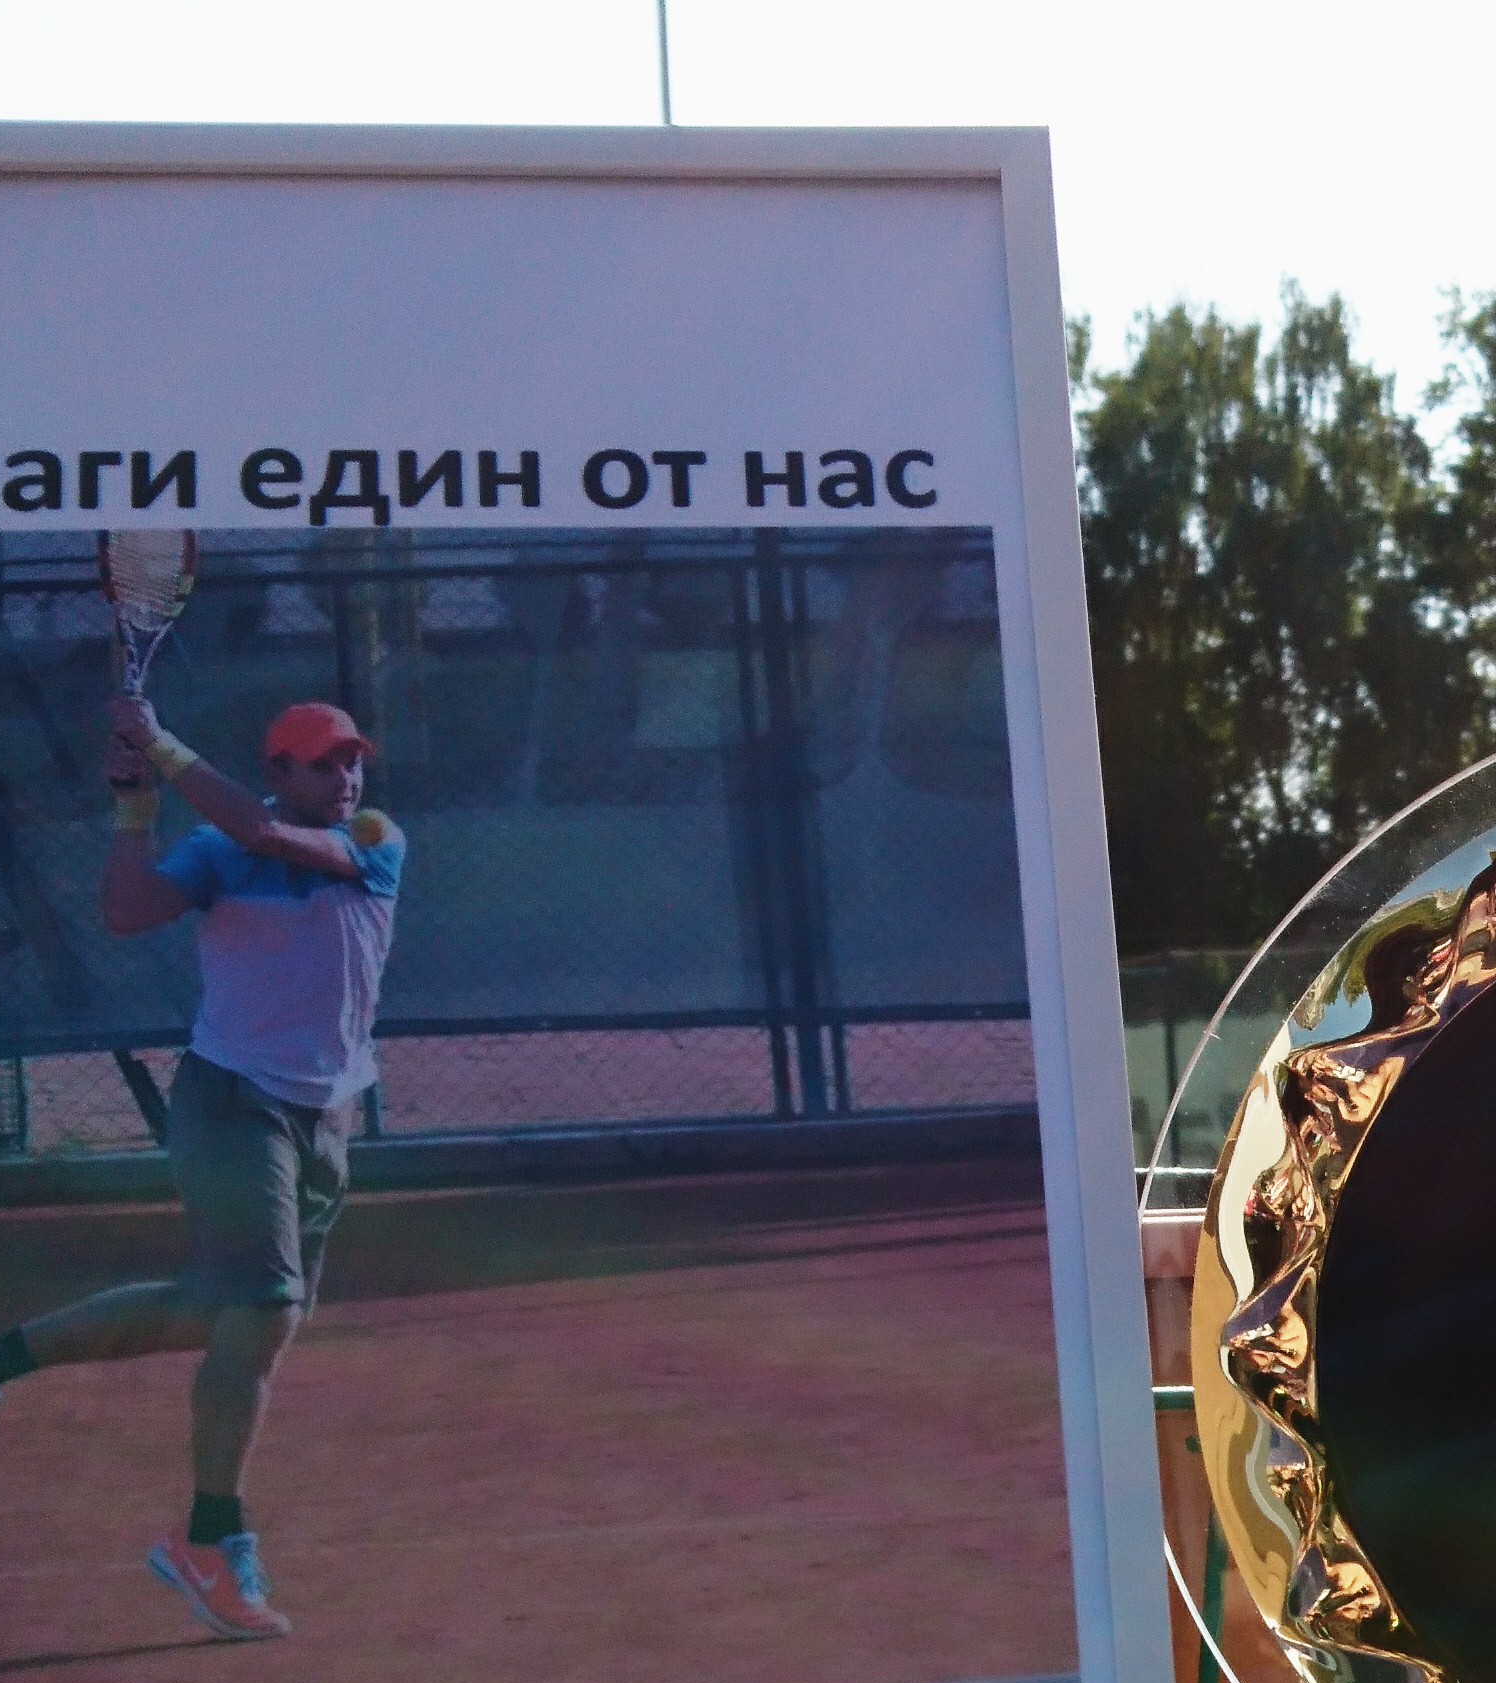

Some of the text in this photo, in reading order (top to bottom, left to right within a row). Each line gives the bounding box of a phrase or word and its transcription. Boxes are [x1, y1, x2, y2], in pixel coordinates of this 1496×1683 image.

[241, 448, 540, 526] един
[583, 449, 706, 509] от
[745, 450, 936, 508] нас
